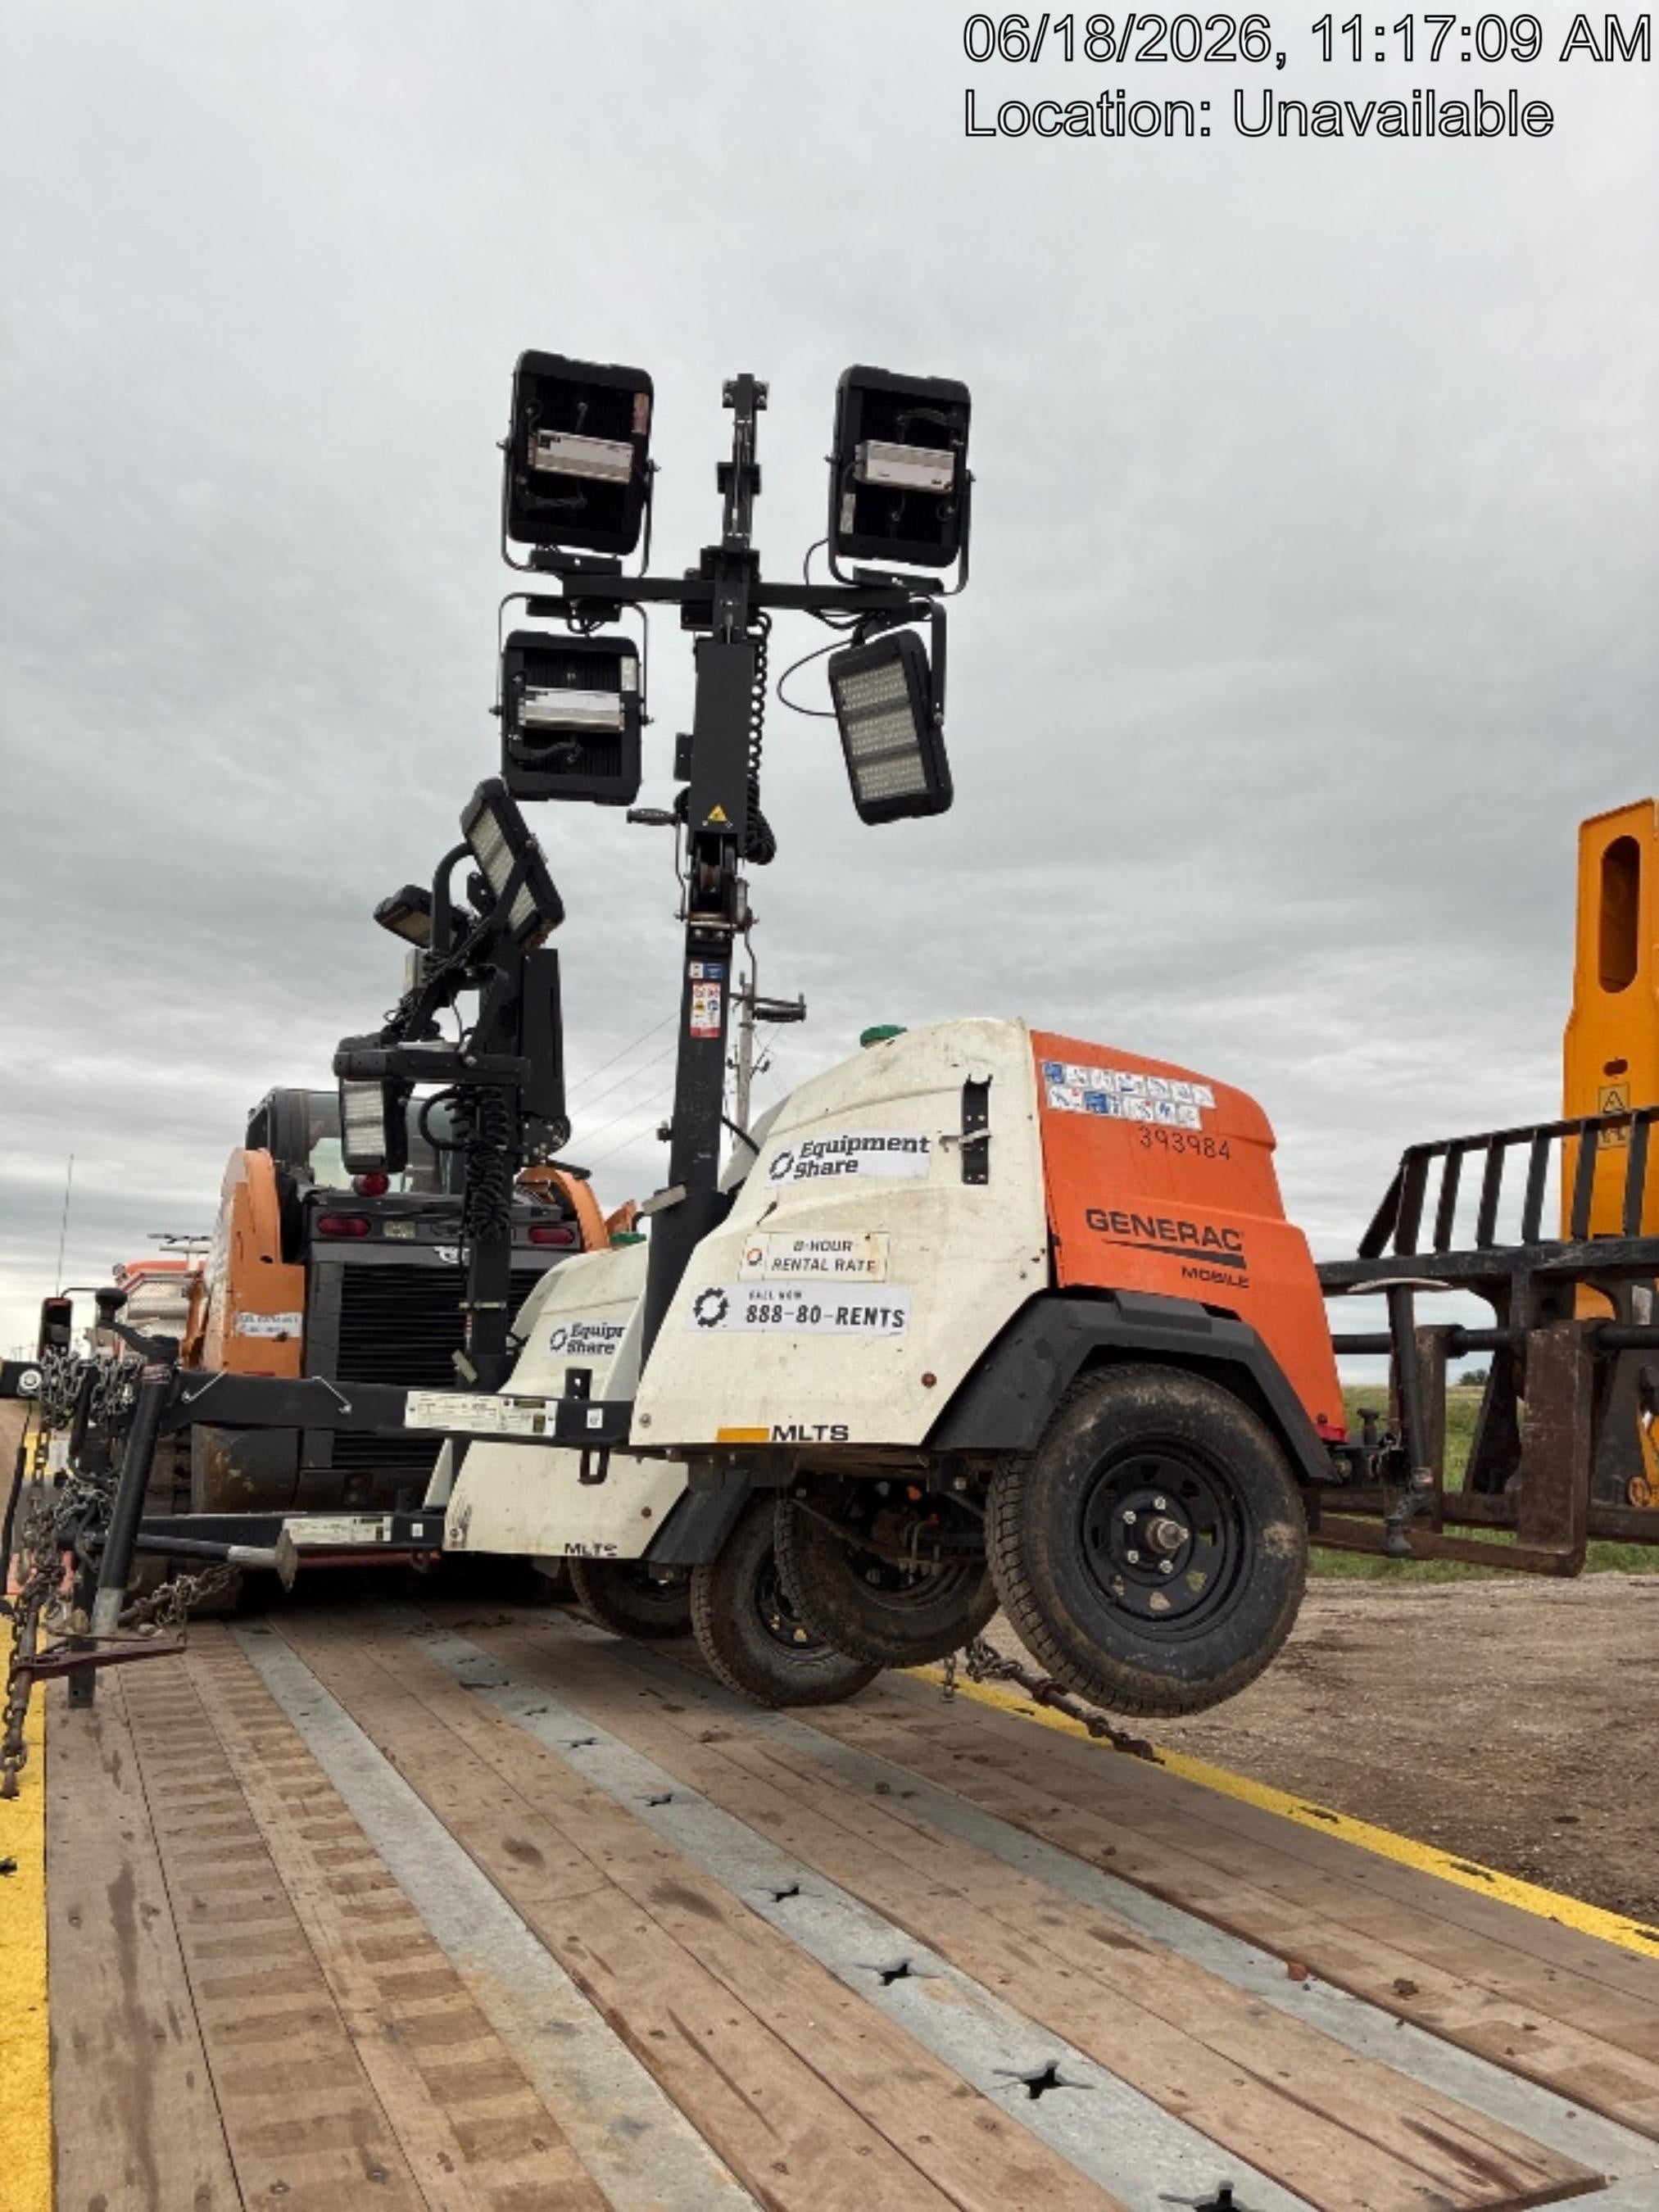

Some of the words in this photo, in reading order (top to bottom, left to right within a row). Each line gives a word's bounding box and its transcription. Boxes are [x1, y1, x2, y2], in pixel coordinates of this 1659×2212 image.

[799, 1135, 931, 1159] Equipment
[1138, 1125, 1231, 1161] 393984
[793, 1159, 859, 1180] Share
[1086, 1208, 1243, 1251] GENERAC
[771, 1257, 830, 1271] RENTAL
[834, 1258, 877, 1272] RATE
[1181, 1267, 1249, 1289] MOBILE
[746, 1303, 906, 1328] 888-80-RENTS
[773, 1424, 849, 1442] MLTS
[564, 1542, 618, 1557] MLTS
